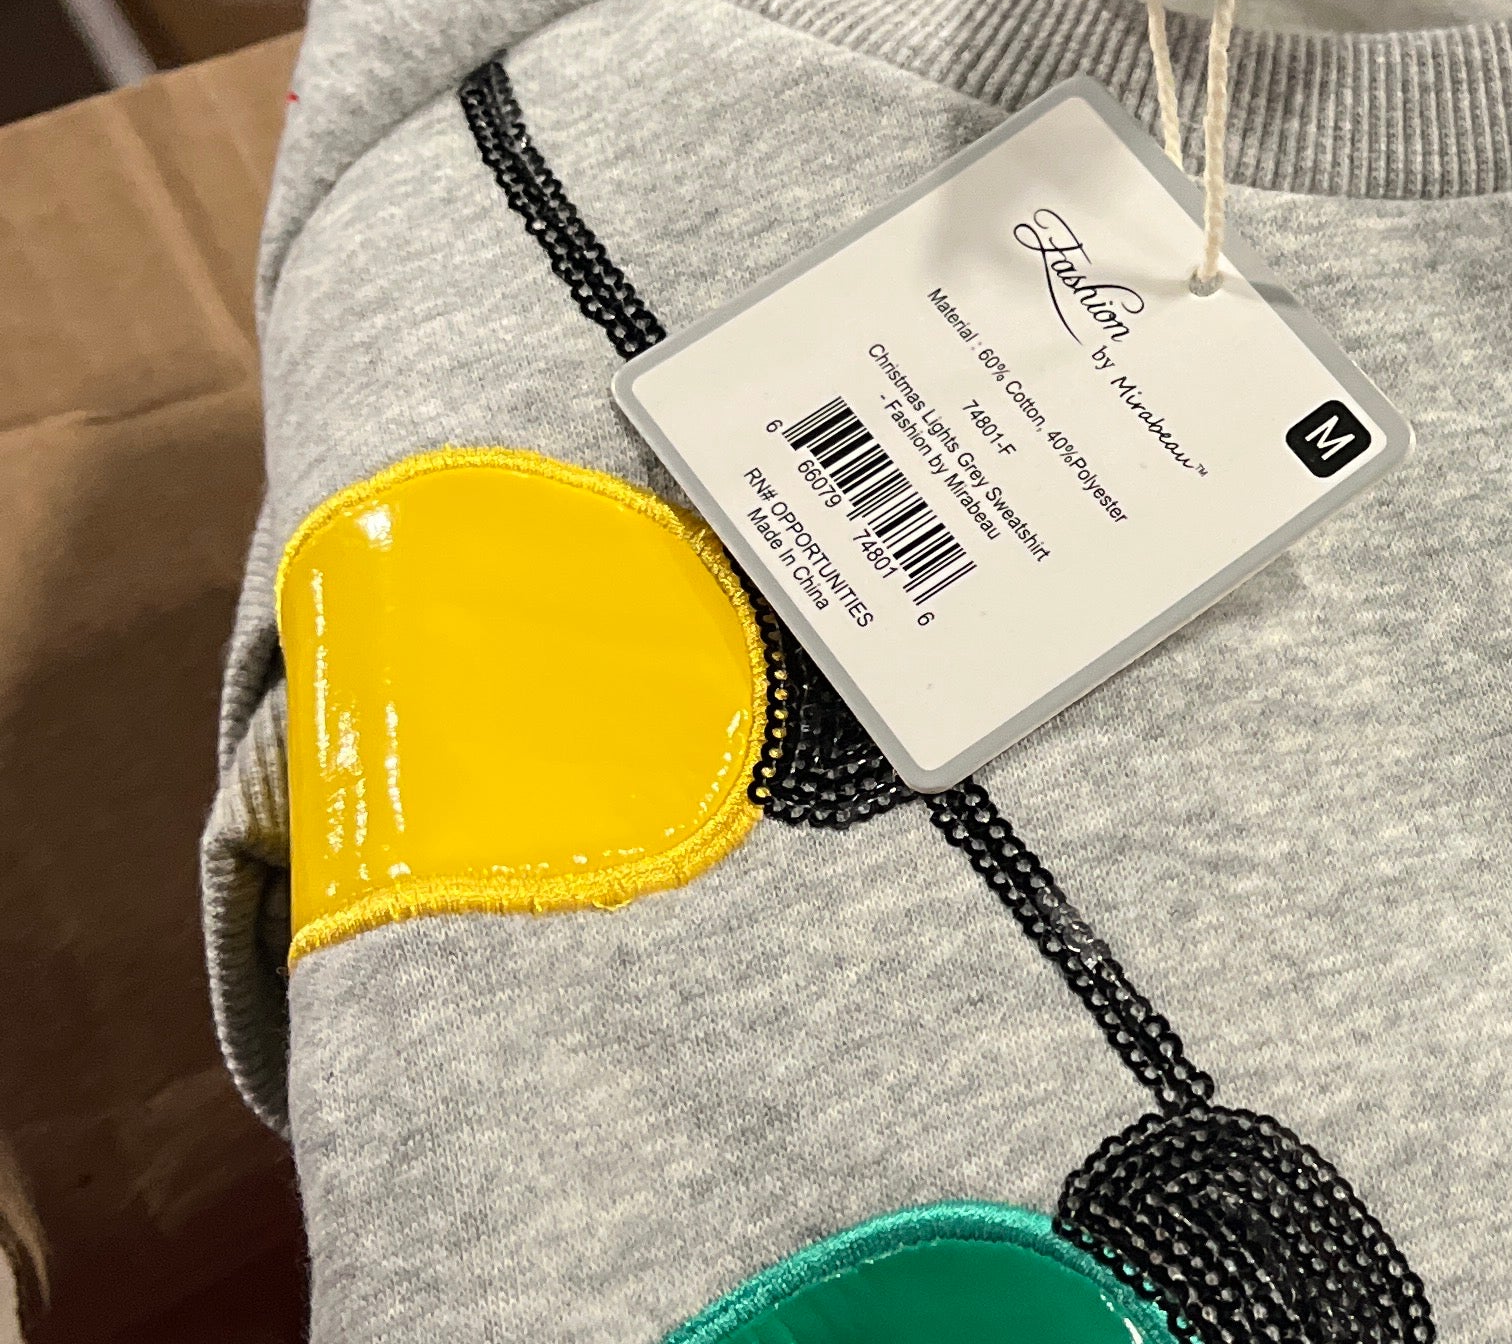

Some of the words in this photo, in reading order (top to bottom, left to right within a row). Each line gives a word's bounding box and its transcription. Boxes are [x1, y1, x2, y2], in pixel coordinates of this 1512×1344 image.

[1012, 208, 1145, 346] Fashion
[927, 287, 979, 343] Material
[977, 347, 1011, 383] 60%
[1005, 380, 1046, 433] Cotton,
[1091, 344, 1116, 370] by
[868, 343, 926, 412] Christmas
[921, 408, 960, 454] Lights
[957, 451, 990, 489] Grey
[985, 486, 1051, 563] Sweatshirt
[884, 399, 932, 457] Fashion
[927, 453, 949, 476] by
[943, 472, 1002, 541] Mirabeau
[962, 399, 1017, 456] 74801-F
[1303, 415, 1357, 461] M
[743, 466, 779, 502] RN#
[770, 501, 874, 628] OPPORTUNITIES
[746, 506, 784, 551] Made
[778, 547, 797, 568] In
[792, 565, 830, 612] China
[765, 418, 784, 434] 6
[797, 459, 843, 509] 66079
[852, 528, 899, 580] 74801
[917, 611, 936, 627] 6
